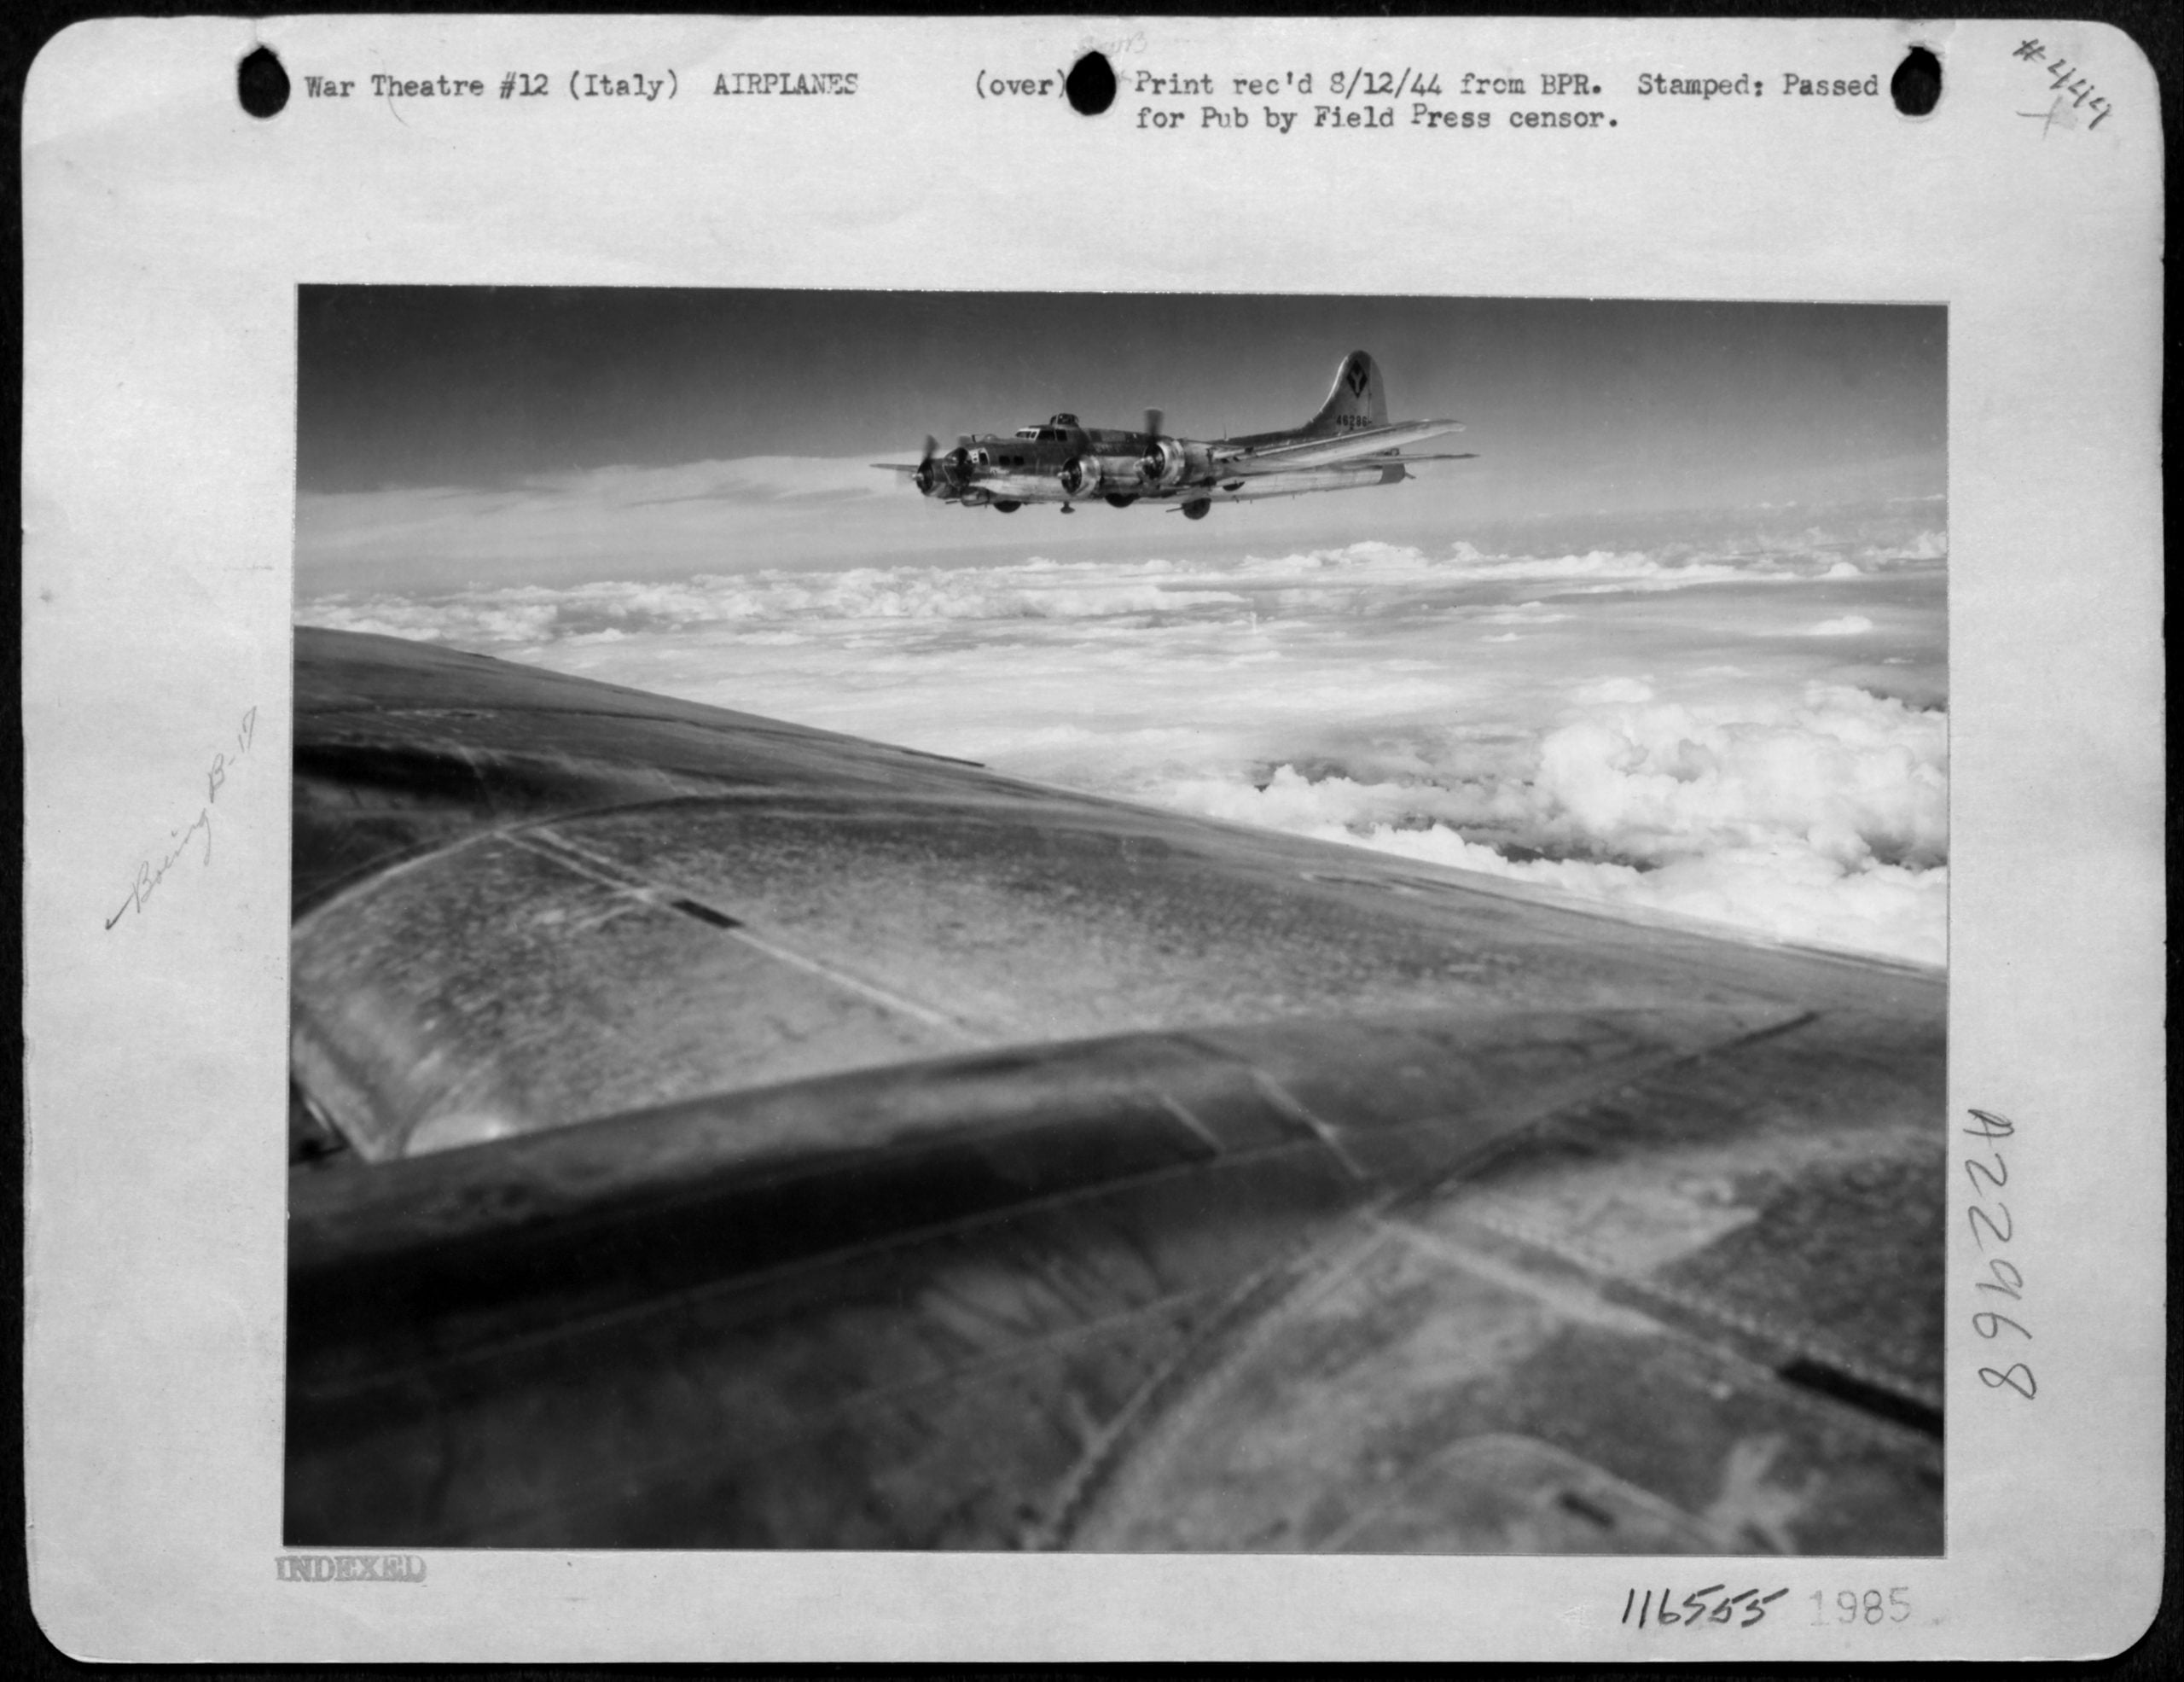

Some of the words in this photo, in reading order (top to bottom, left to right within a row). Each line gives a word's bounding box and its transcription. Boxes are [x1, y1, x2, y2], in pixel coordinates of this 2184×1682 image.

[304, 75, 356, 98] War
[370, 73, 485, 97] Theatre
[499, 72, 549, 100] #12
[569, 68, 678, 102] (Italy)
[713, 73, 858, 96] AIRPLANES
[976, 68, 1066, 99] (over)
[1135, 70, 1213, 96] Print
[1233, 71, 1312, 96] rec'd
[1329, 67, 1443, 100] 8/12/44
[1460, 72, 1527, 95] from
[1541, 73, 1602, 96] BPR.
[1637, 73, 1764, 101] Stamped:
[1782, 73, 1879, 96] Passed
[1136, 107, 1186, 129] for
[1201, 106, 1249, 129] Pub
[1263, 106, 1298, 135] by
[1314, 105, 1395, 128] Field
[1411, 102, 1491, 129] Press
[1508, 111, 1618, 129] censor.
[274, 1554, 427, 1583] INDEXED
[1621, 1583, 1790, 1629] 116555
[1809, 1586, 1912, 1627] 1985
